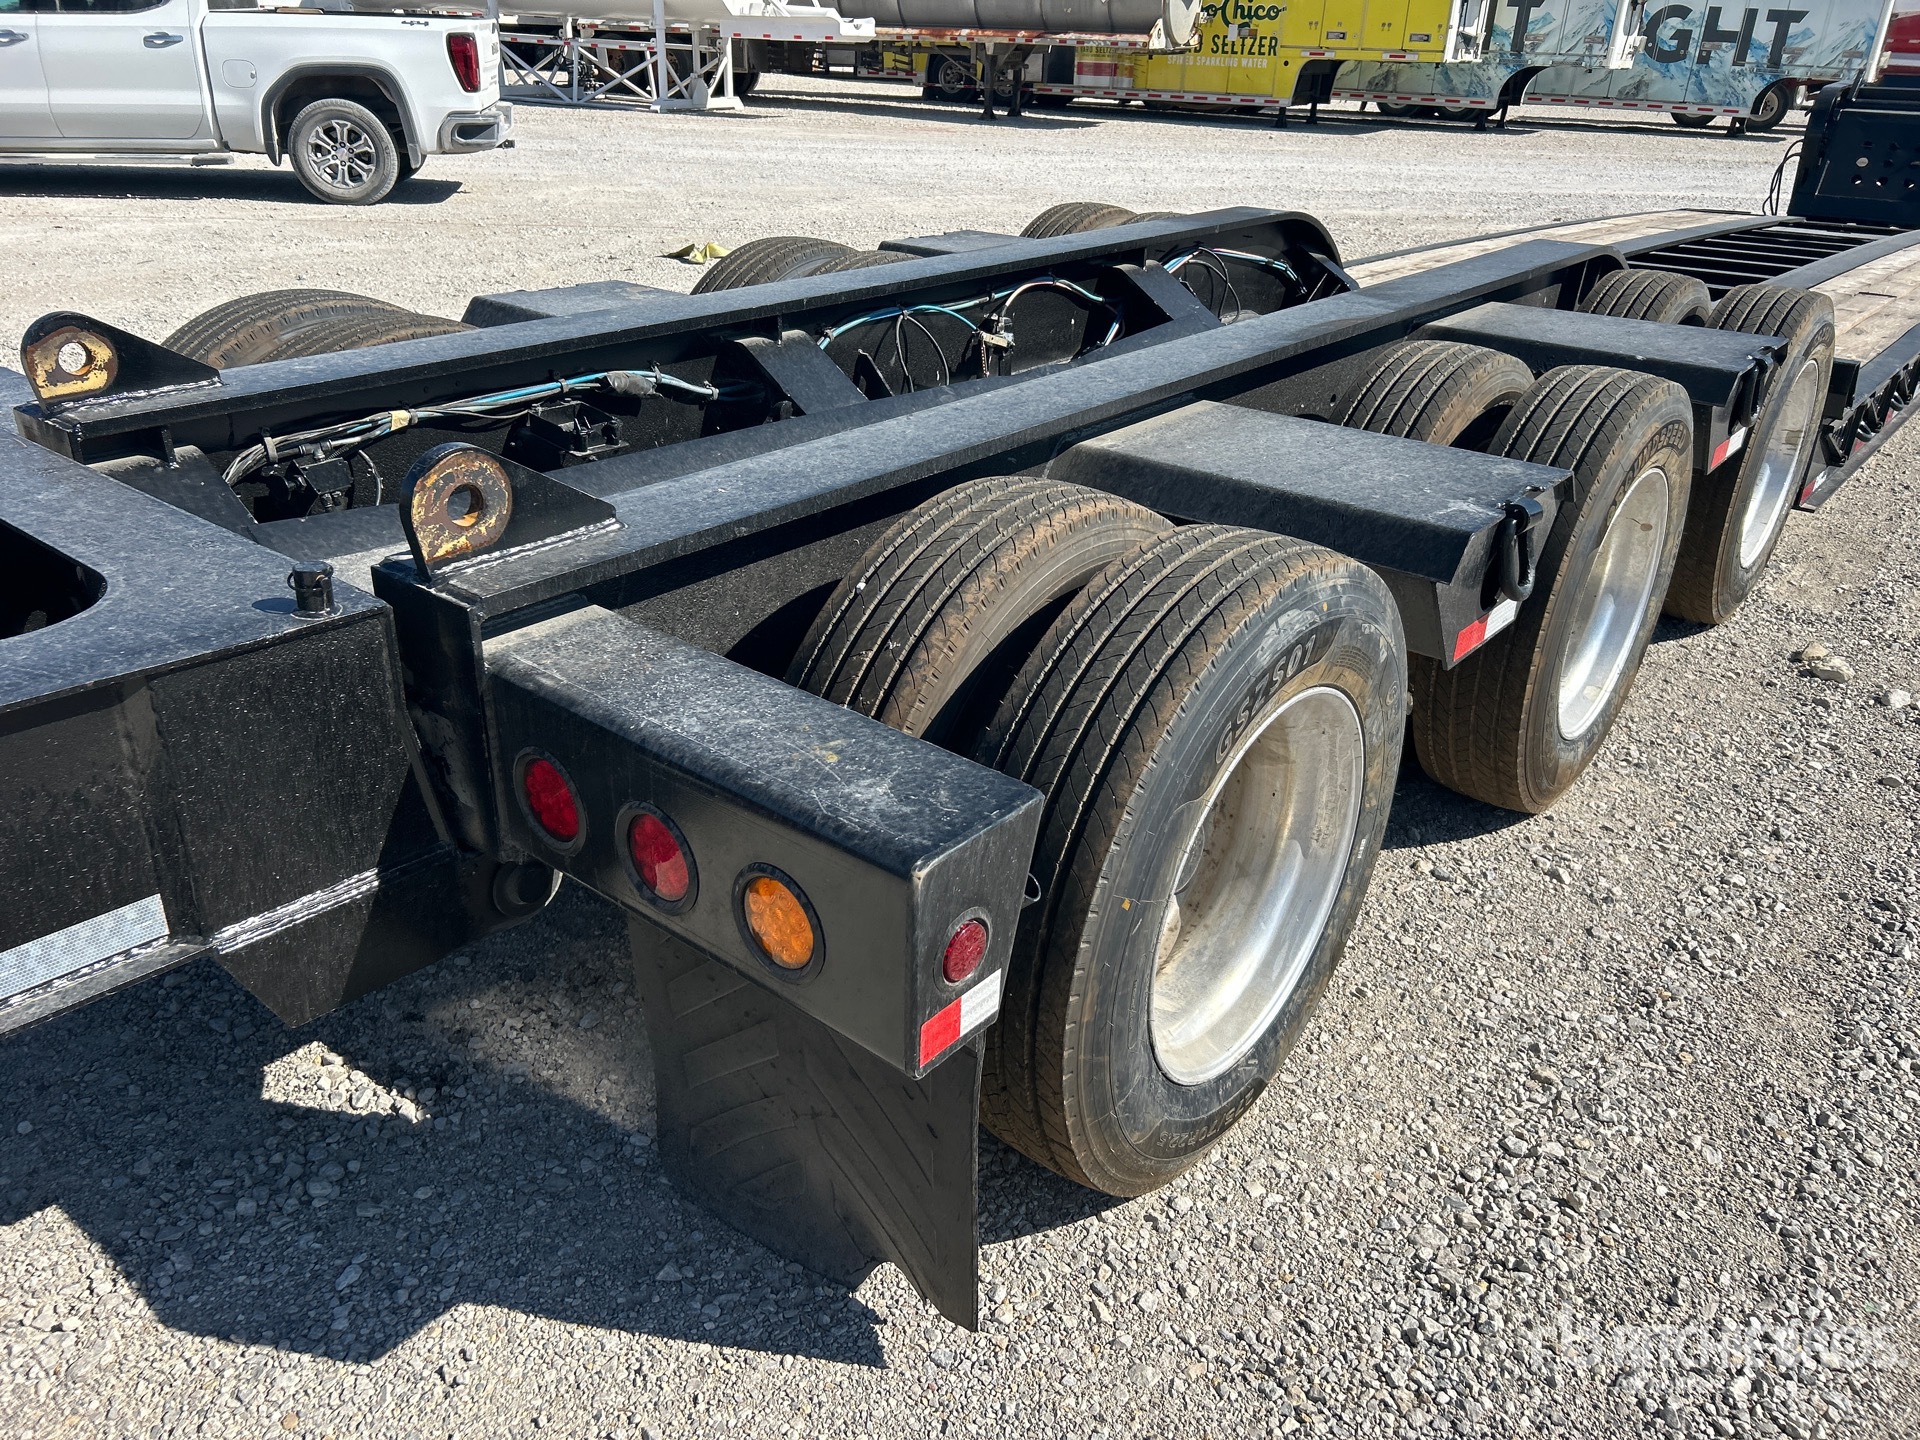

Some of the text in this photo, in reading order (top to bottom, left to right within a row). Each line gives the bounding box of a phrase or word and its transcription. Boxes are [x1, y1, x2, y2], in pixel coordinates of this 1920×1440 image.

[1211, 33, 1279, 56] SELTZER
[1196, 56, 1239, 67] SPARKLING
[1241, 58, 1268, 69] WATER
[1215, 634, 1317, 765] GSZS01
